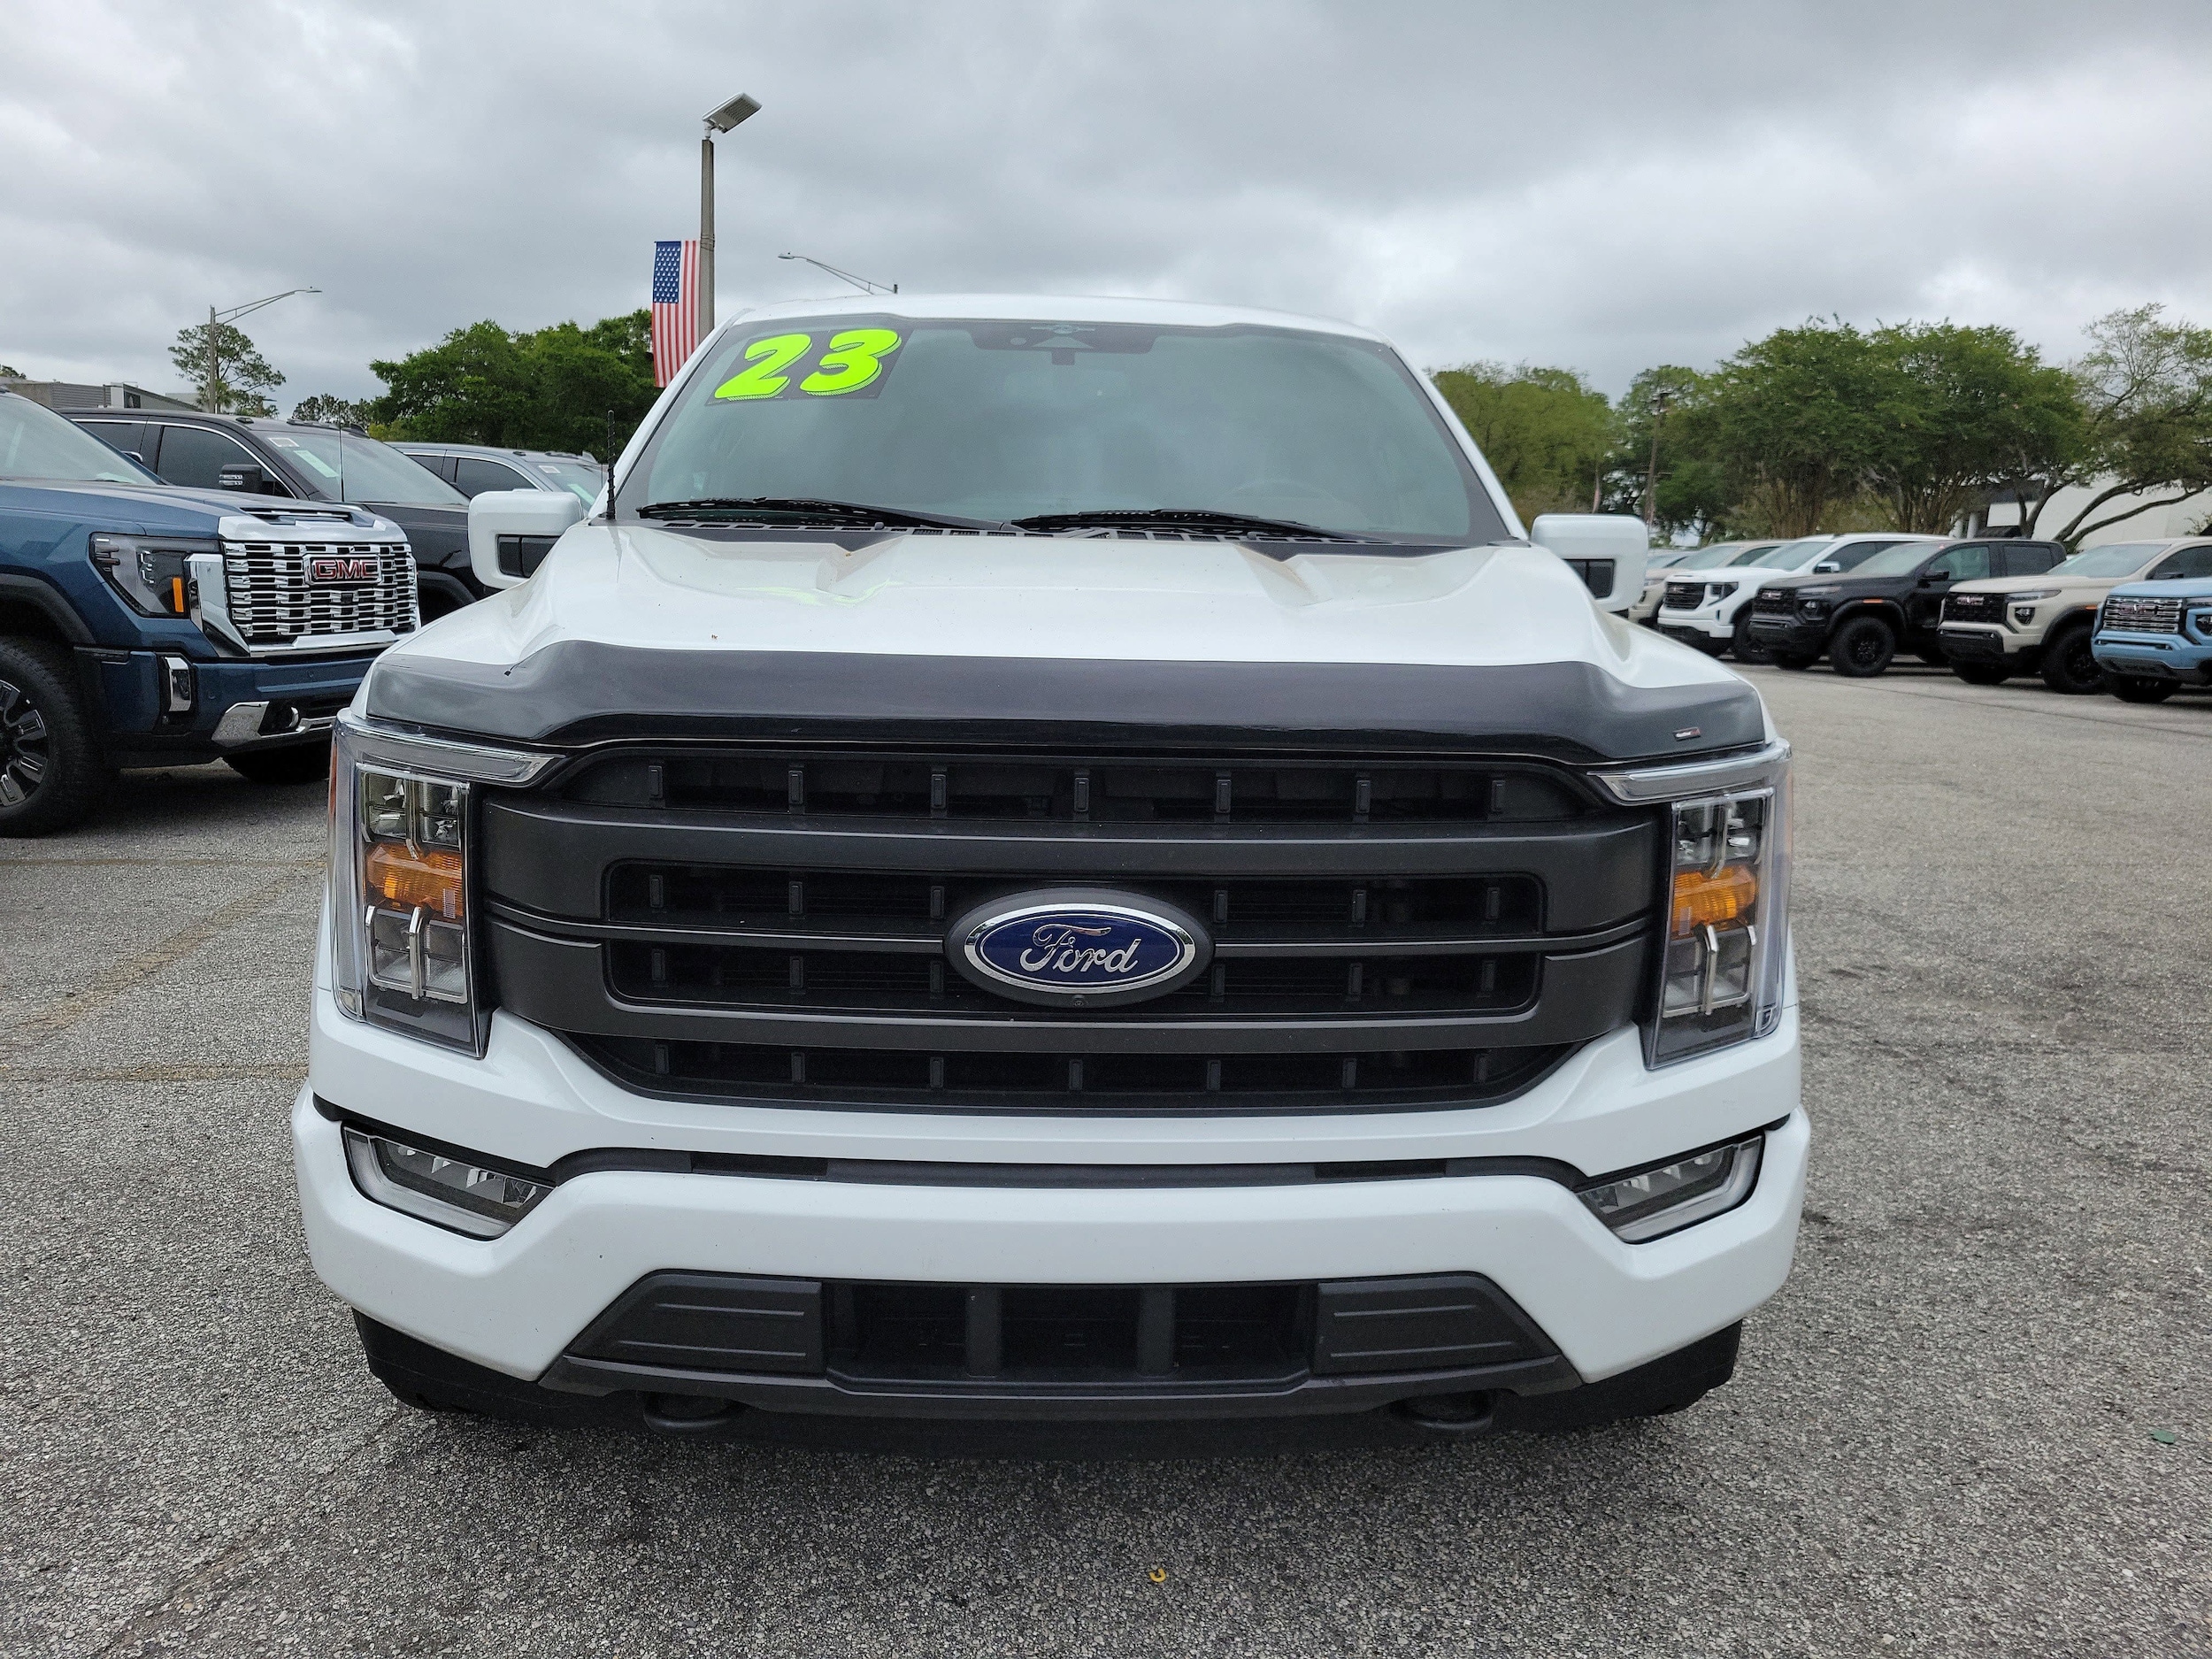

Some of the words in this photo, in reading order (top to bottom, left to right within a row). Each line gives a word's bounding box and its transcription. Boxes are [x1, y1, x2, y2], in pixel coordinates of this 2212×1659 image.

[714, 328, 902, 401] 23
[312, 558, 379, 580] GMC
[1019, 923, 1142, 973] Ford
